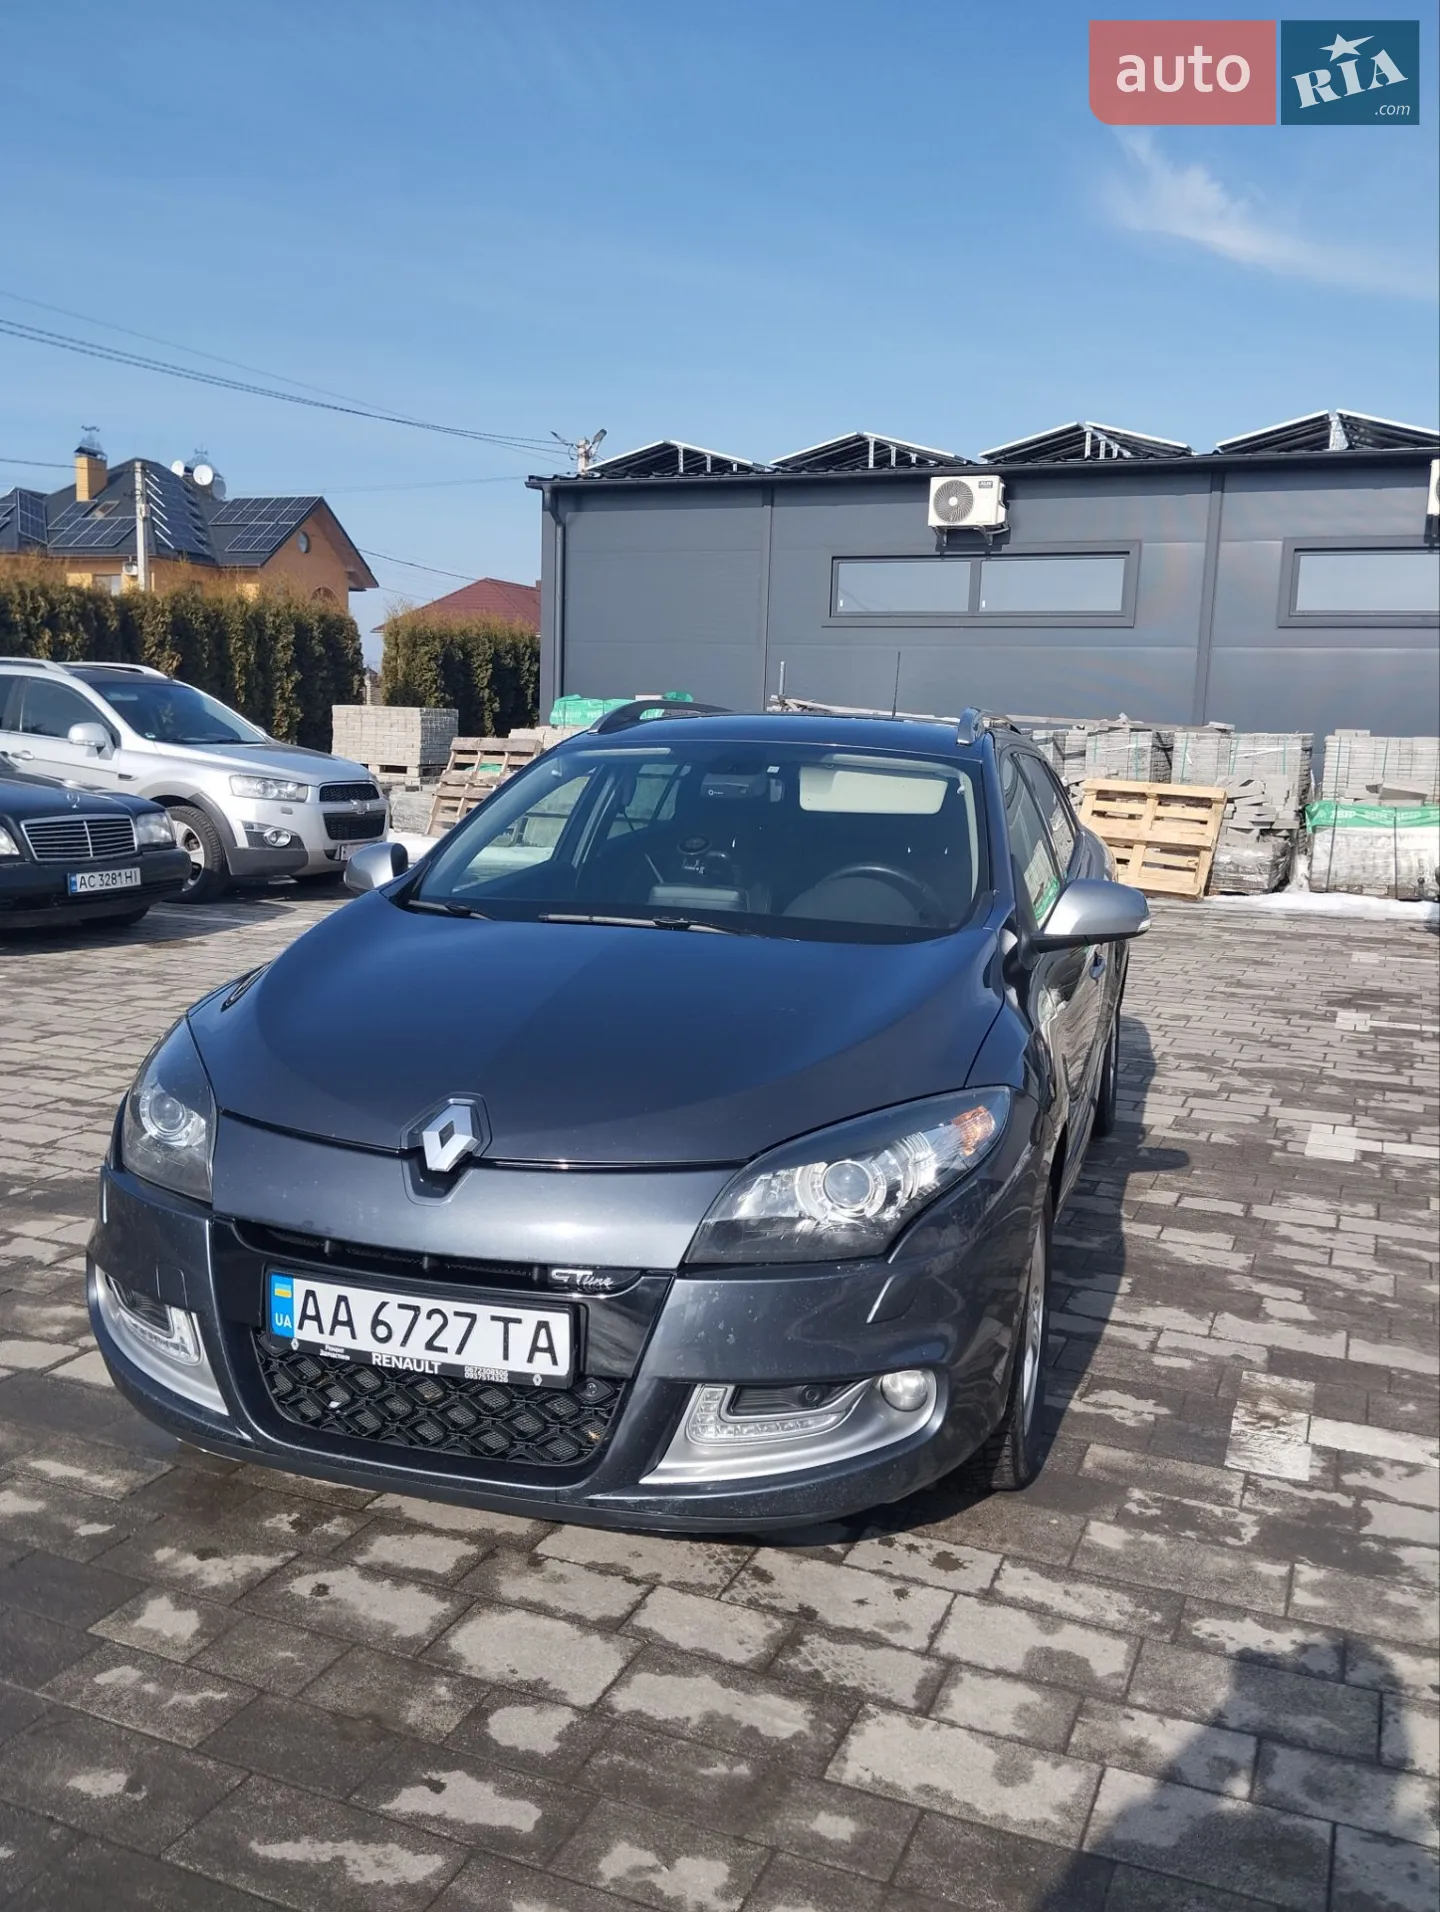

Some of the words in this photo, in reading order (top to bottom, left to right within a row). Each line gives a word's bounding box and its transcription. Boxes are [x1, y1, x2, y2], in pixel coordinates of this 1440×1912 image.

[79, 875, 96, 889] AC
[98, 871, 123, 887] 3281
[275, 1313, 292, 1328] UA
[297, 1289, 357, 1340] AA
[370, 1301, 478, 1355] 6727
[489, 1315, 559, 1366] TA
[371, 1353, 442, 1374] RENAULT
